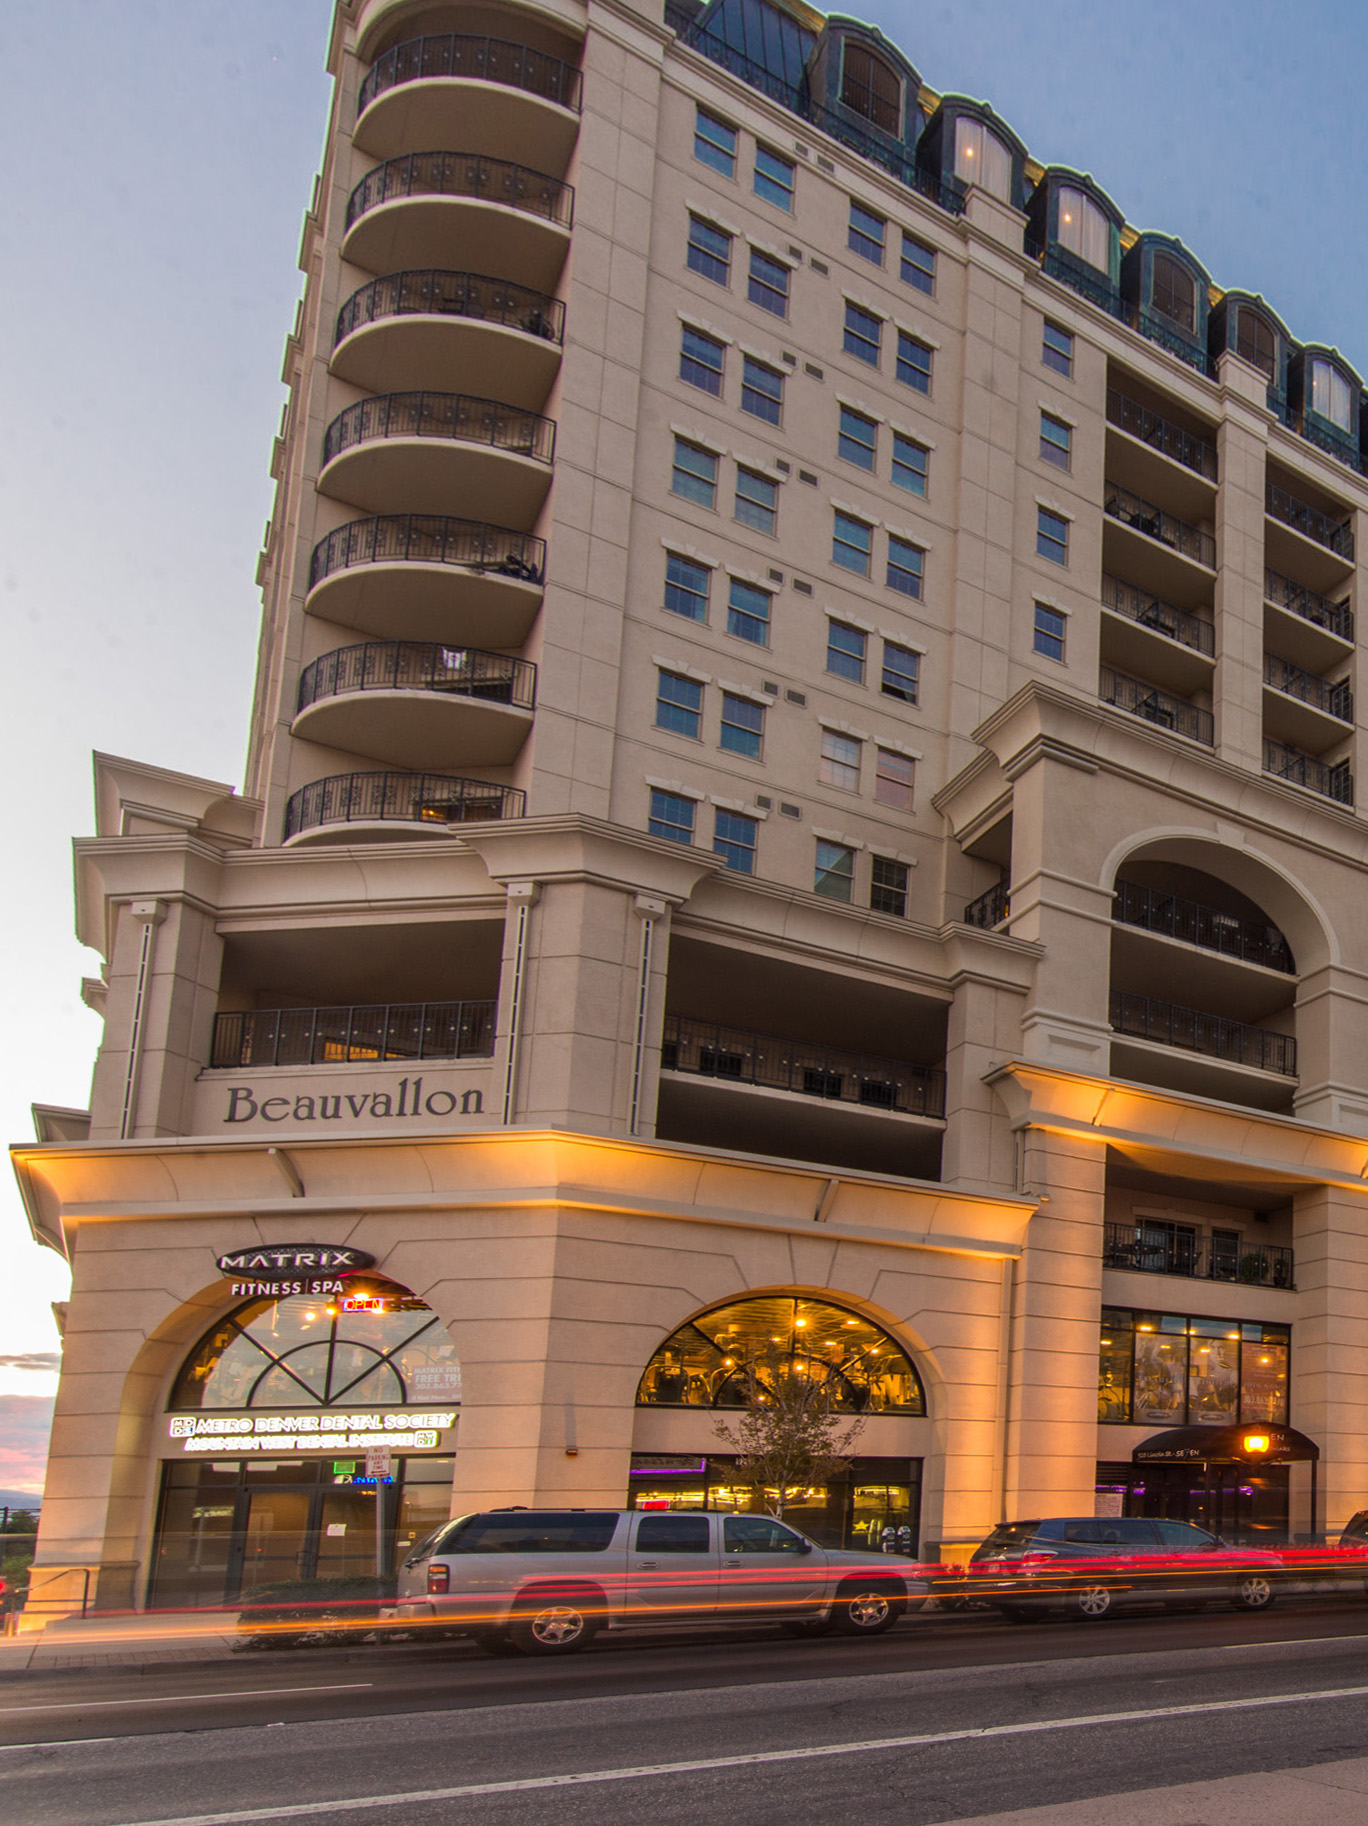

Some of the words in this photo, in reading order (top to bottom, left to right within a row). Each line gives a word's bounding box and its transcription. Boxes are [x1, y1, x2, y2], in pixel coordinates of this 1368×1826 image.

[223, 1077, 485, 1123] Beauvallon
[220, 1252, 354, 1269] MATRIX
[231, 1282, 302, 1296] FITNESS
[311, 1280, 344, 1294] SPA
[345, 1299, 382, 1311] OPEN
[415, 1374, 441, 1383] FREE
[197, 1418, 254, 1433] METRO
[254, 1416, 320, 1432] DENVER
[320, 1415, 383, 1431] DENTAL
[384, 1413, 456, 1429] SOCIETY
